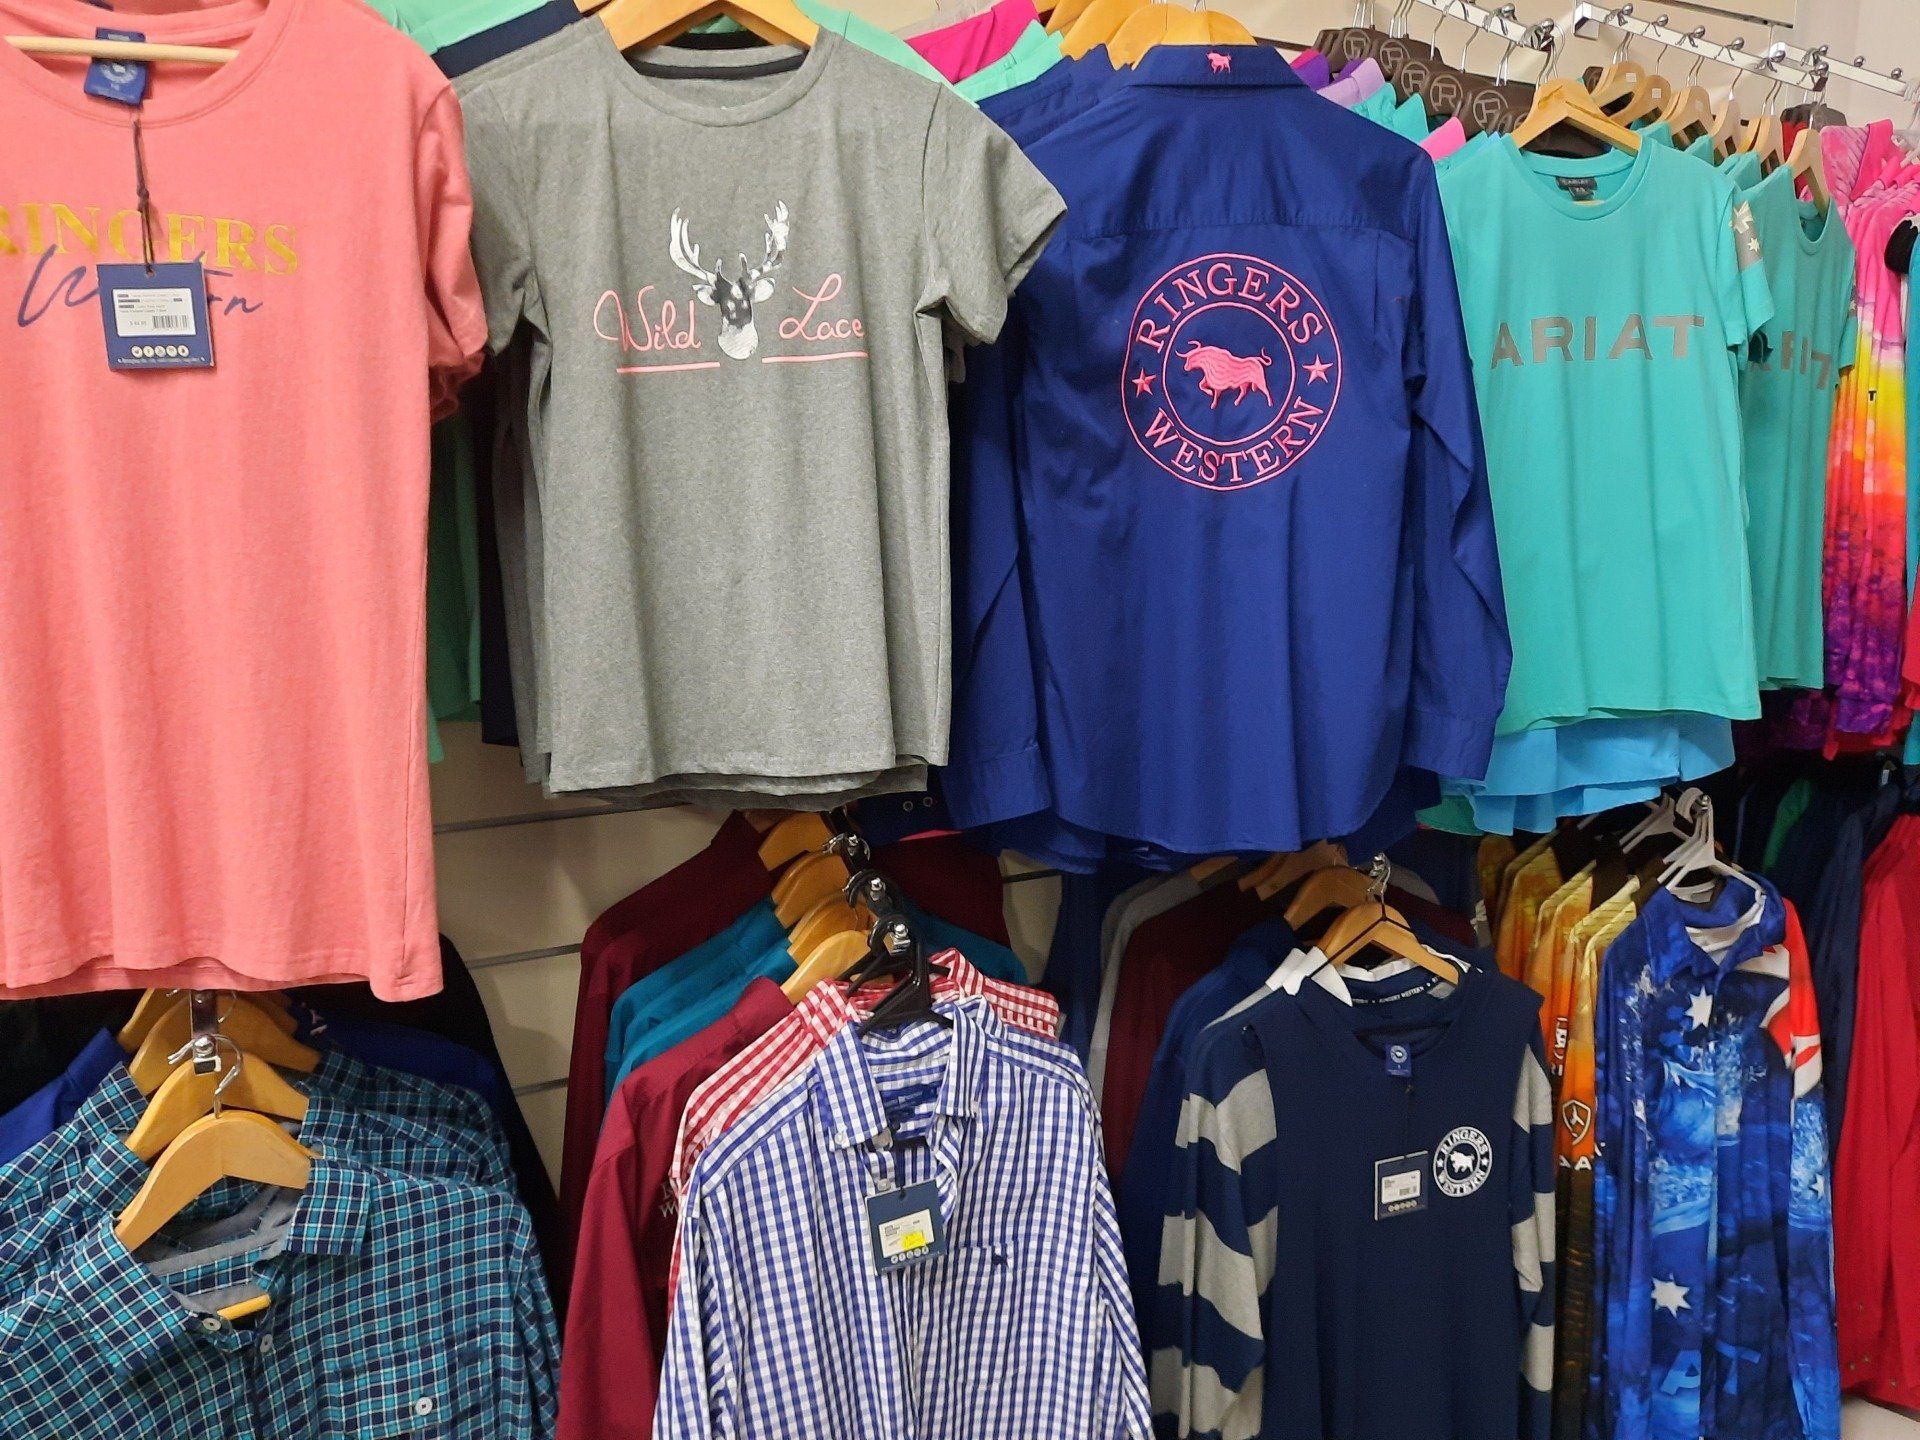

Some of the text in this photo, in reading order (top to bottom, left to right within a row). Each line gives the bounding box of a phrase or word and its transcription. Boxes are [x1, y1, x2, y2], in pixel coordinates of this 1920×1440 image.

[593, 273, 866, 351] Wild Lace
[1136, 262, 1324, 353] RINGERS
[1489, 312, 1706, 371] ARIAT
[1144, 396, 1325, 484] WESTERN
[1440, 1127, 1490, 1155] RINGERS
[1438, 1168, 1487, 1196] WESTERN
